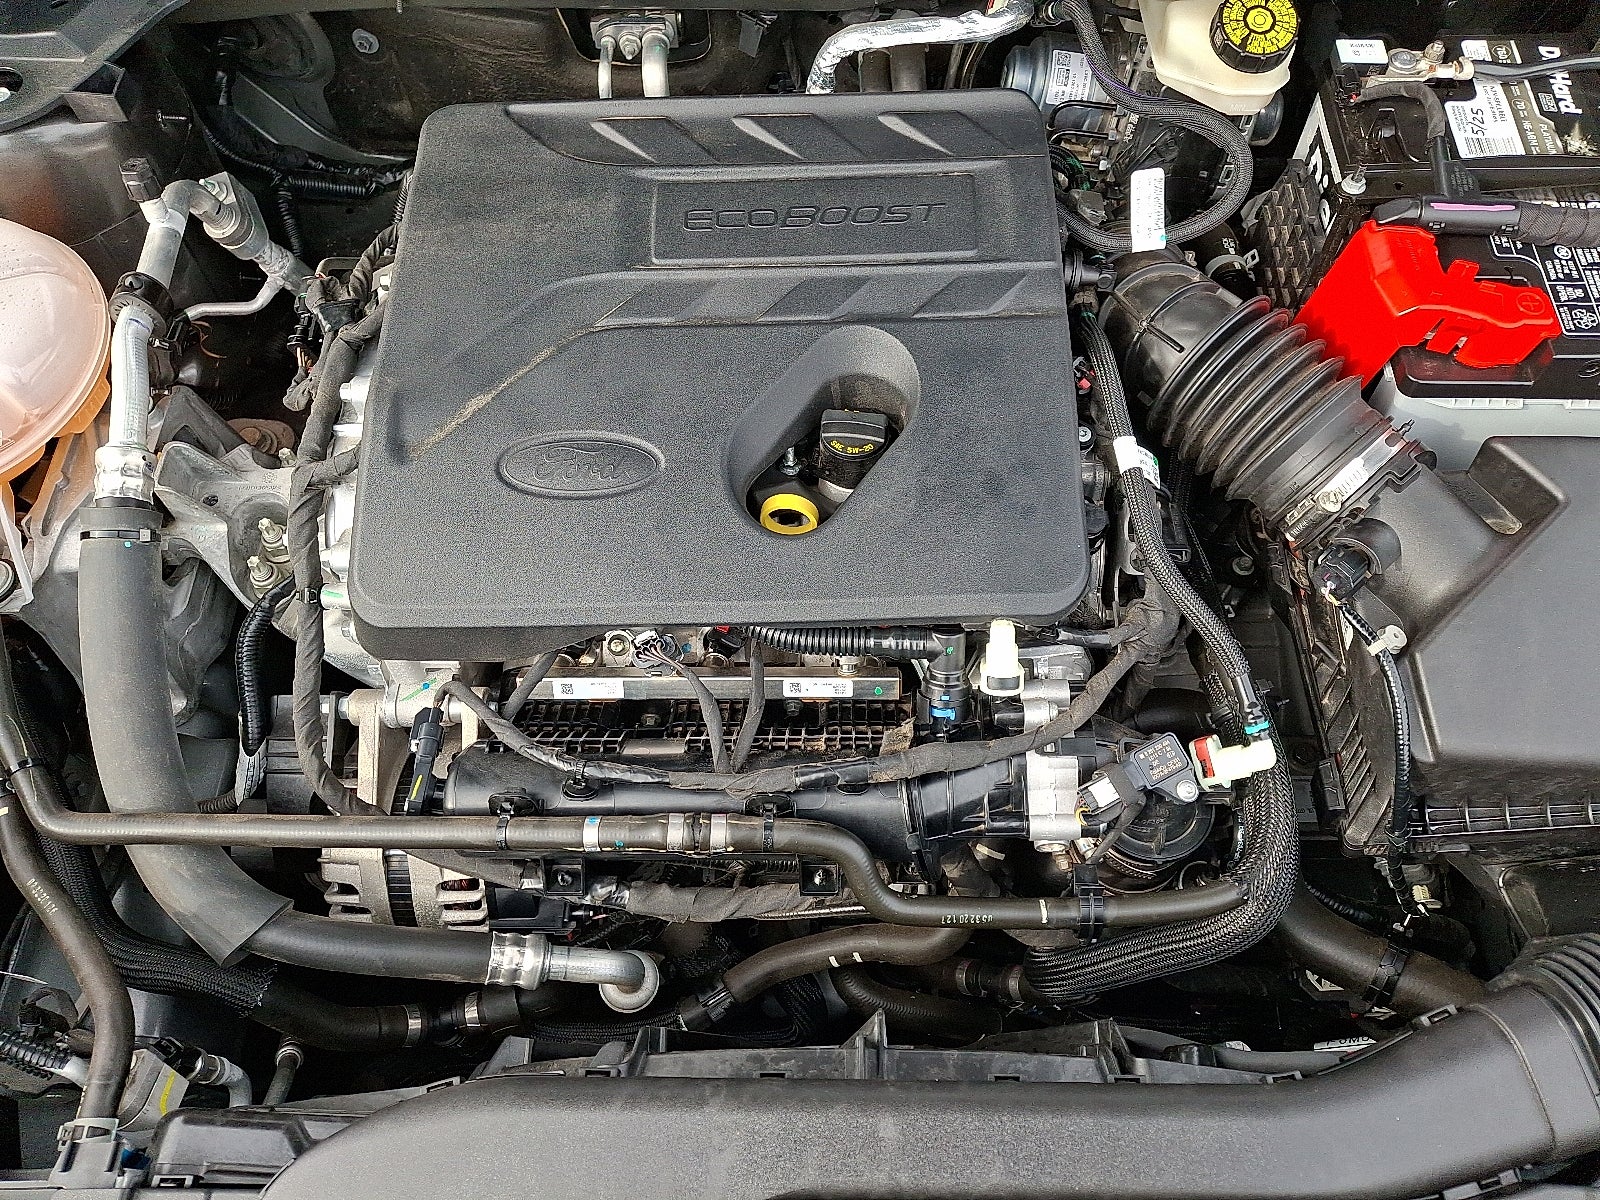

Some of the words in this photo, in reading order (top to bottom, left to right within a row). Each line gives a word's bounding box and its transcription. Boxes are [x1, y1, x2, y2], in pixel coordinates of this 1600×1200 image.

[1468, 107, 1487, 137] 5/25
[683, 202, 946, 231] ECOBOOST
[830, 440, 845, 452] SAE
[846, 443, 874, 454] 5W-20
[534, 446, 631, 482] Ford
